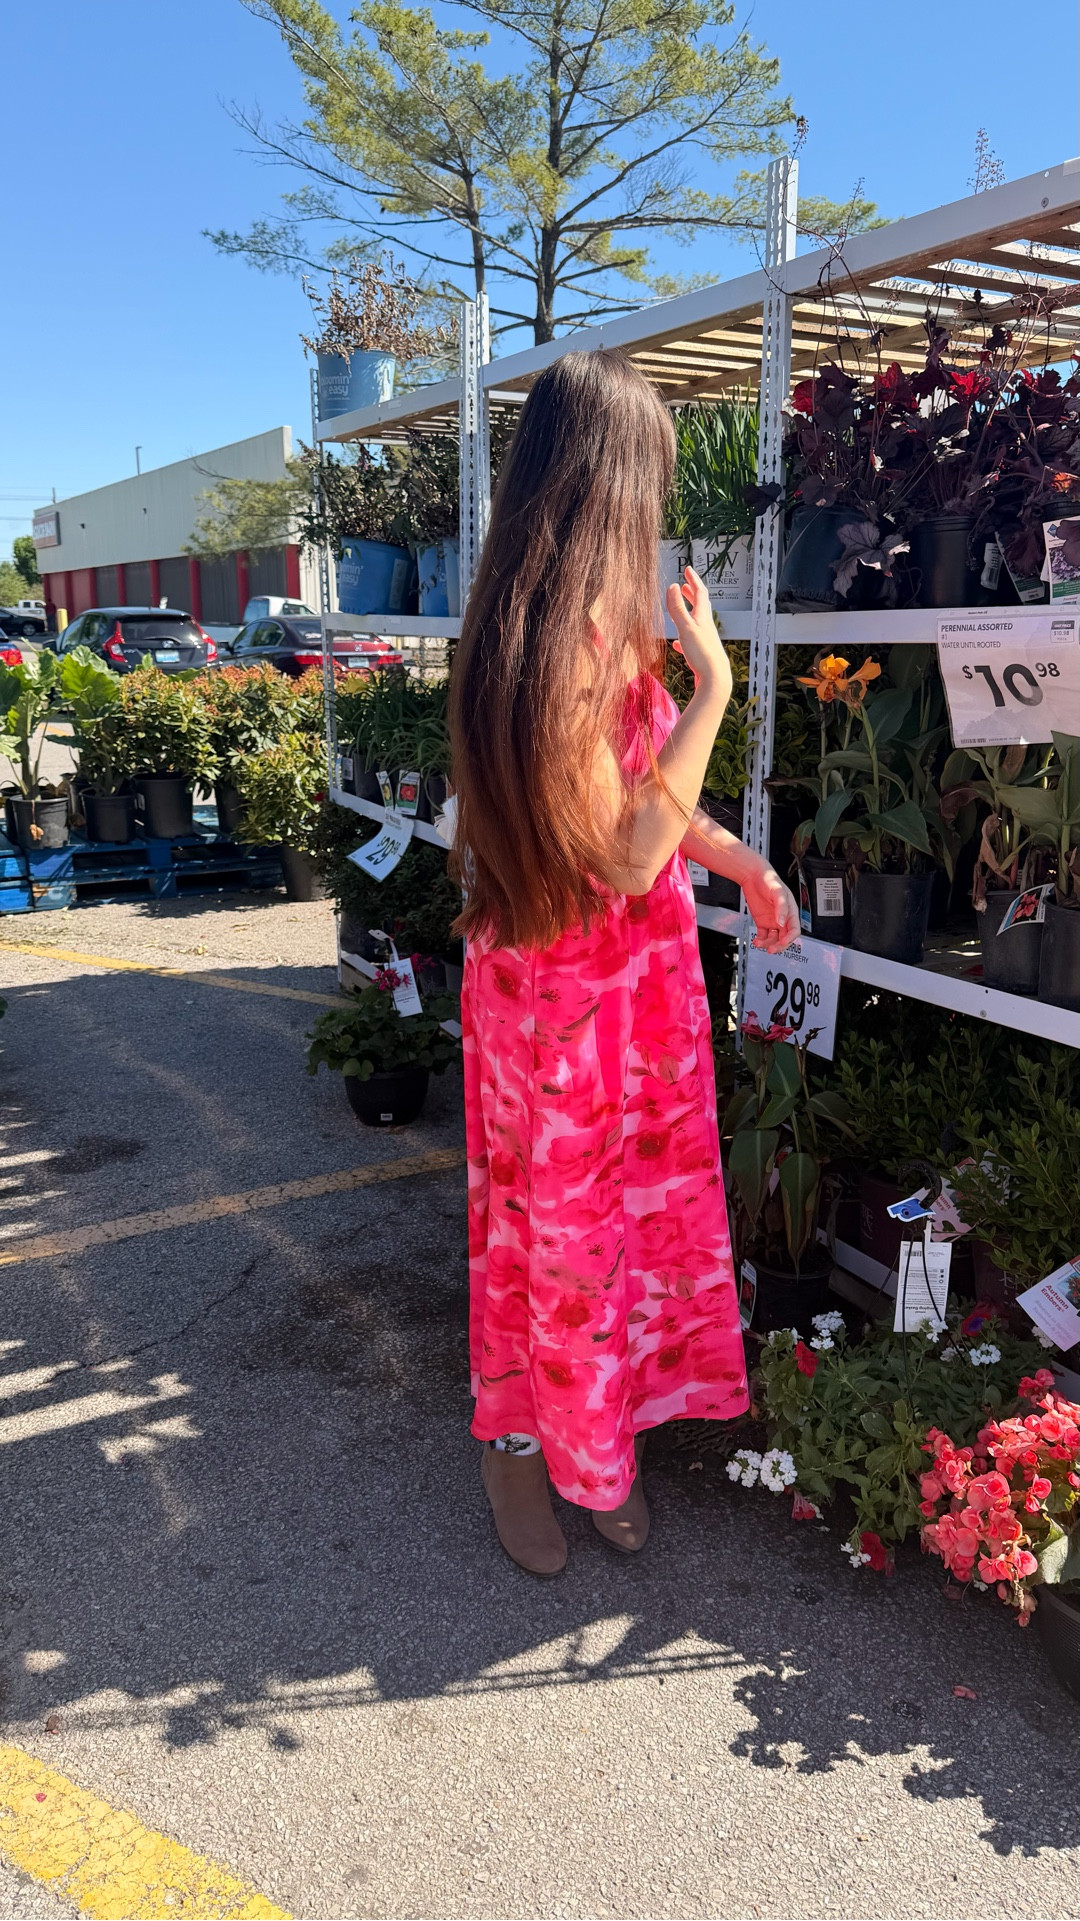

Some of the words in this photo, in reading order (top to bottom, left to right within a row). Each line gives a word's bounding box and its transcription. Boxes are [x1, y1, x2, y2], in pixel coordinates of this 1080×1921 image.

[328, 385, 349, 396] easy
[707, 570, 735, 578] PROEN
[708, 577, 738, 585] INNERS
[941, 624, 976, 632] PERENNIAL
[977, 623, 1013, 631] ASSORTED
[941, 641, 960, 649] WATER
[960, 641, 976, 649] UNTIL
[783, 951, 809, 964] NURSERY
[1041, 1287, 1062, 1312] Embers
[1045, 1284, 1069, 1310] Autumn
